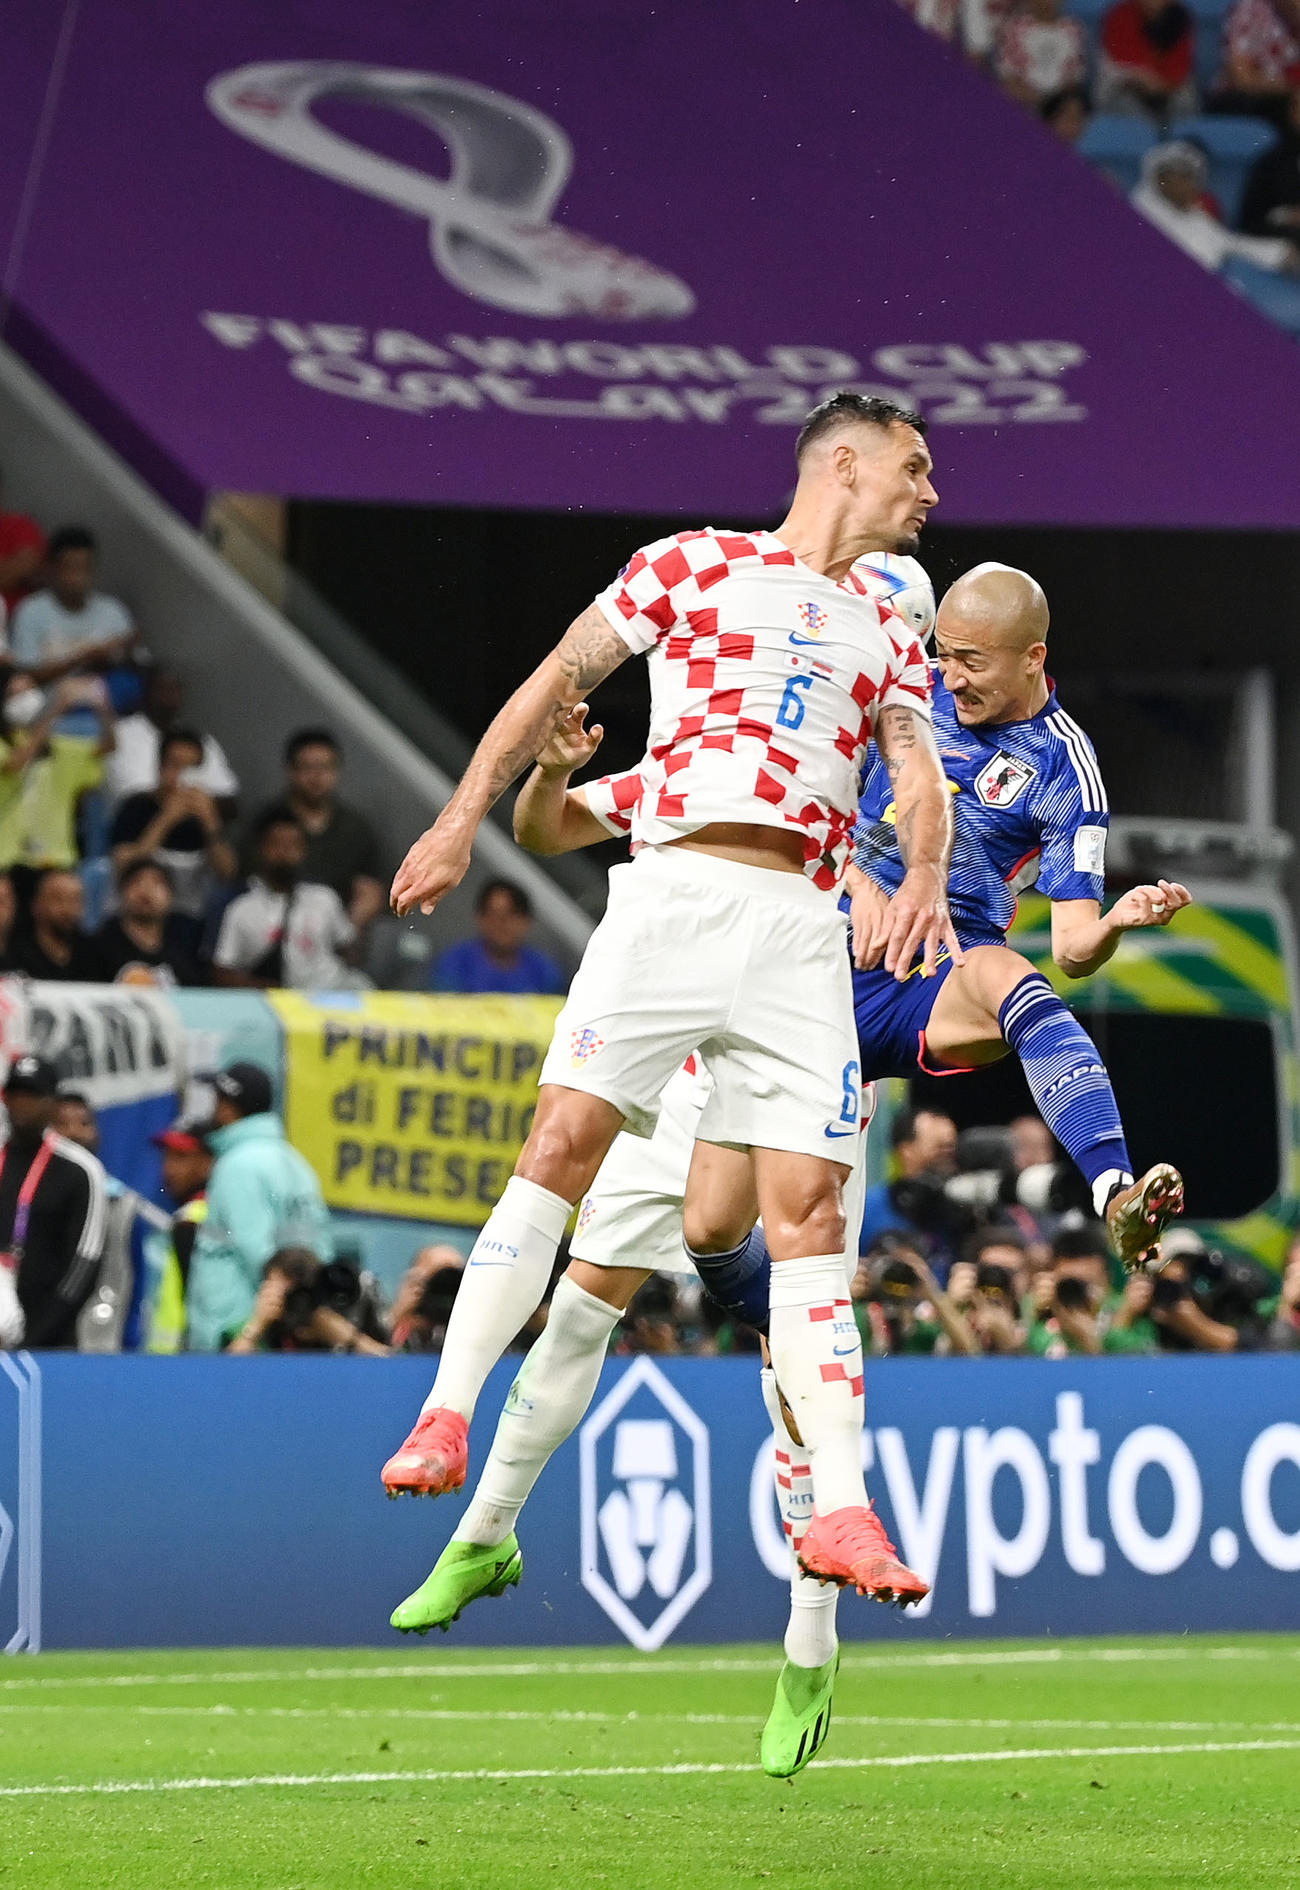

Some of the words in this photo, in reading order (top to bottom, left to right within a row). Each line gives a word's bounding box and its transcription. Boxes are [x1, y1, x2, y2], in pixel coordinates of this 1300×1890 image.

[198, 309, 455, 369] FIFA
[446, 333, 860, 384] WORLD
[871, 340, 1085, 382] CUP
[776, 674, 814, 731] 6
[333, 1078, 376, 1125] di
[839, 1060, 859, 1124] 6
[1045, 1063, 1108, 1099] JAPA
